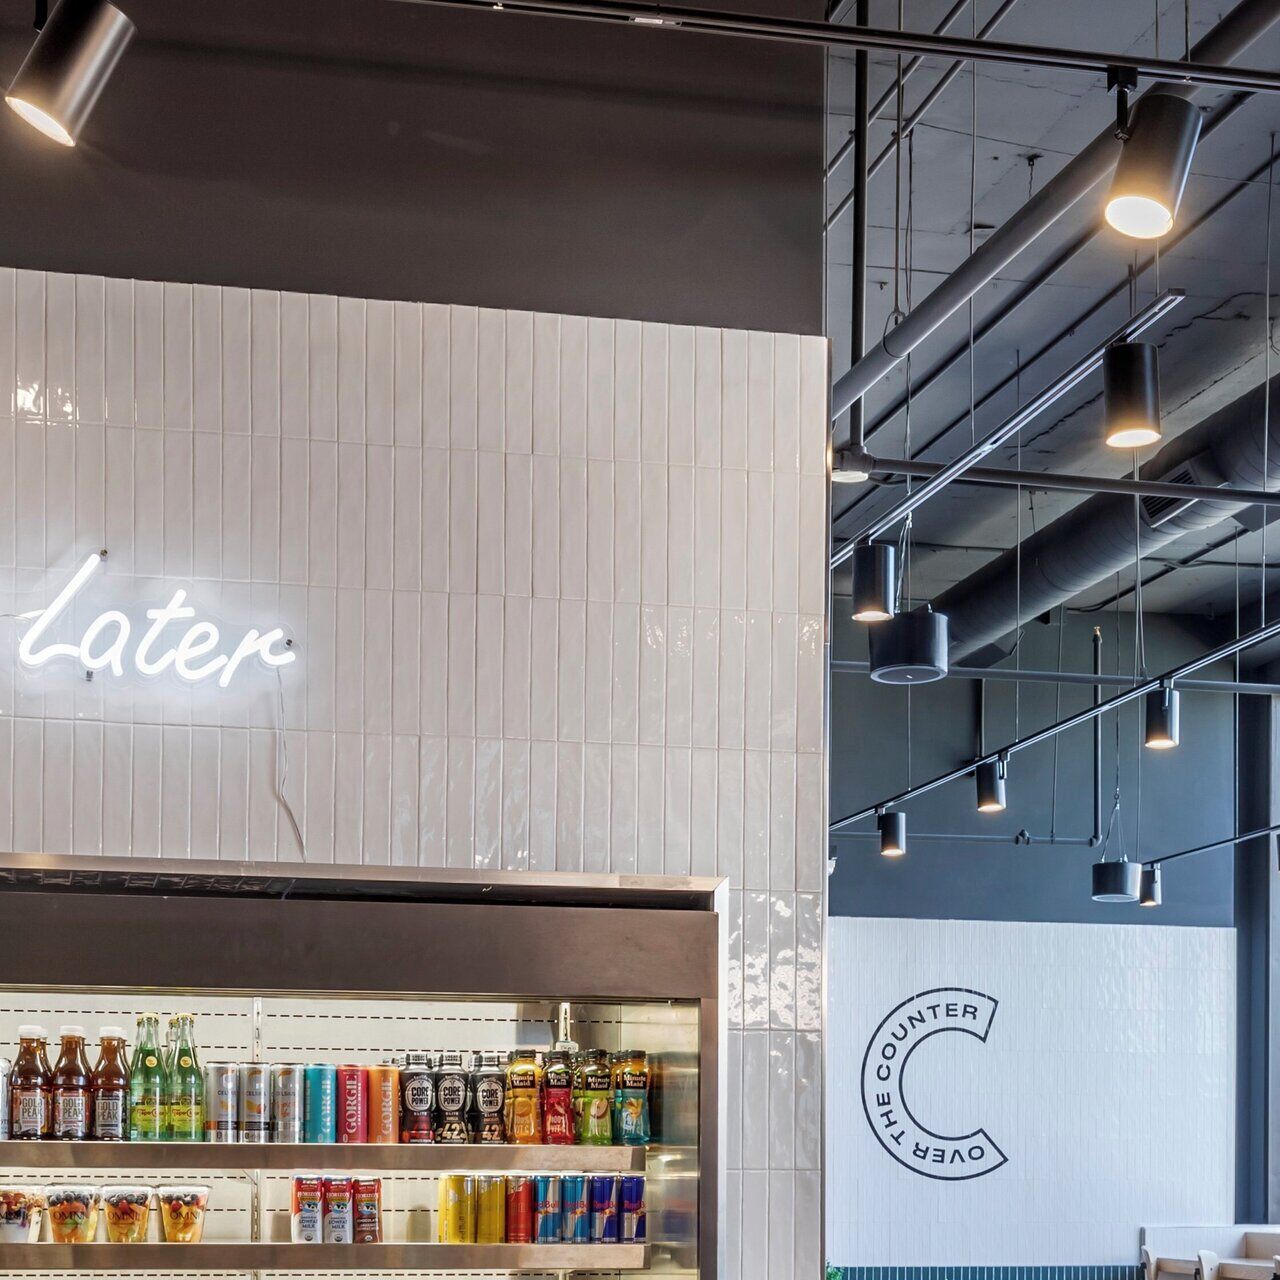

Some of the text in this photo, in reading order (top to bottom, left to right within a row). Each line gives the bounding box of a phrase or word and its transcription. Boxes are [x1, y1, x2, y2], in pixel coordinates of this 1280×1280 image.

[18, 551, 296, 690] Later
[877, 1003, 985, 1164] OVER THE COUNTER
[411, 1086, 429, 1097] CORE
[443, 1086, 461, 1097] CORE
[481, 1088, 499, 1099] CORE
[22, 1097, 42, 1108] GOLD
[97, 1101, 118, 1111] GOLD
[346, 1075, 357, 1135] GORGIE
[443, 1096, 461, 1105] POWER
[482, 1098, 499, 1106] POWER
[22, 1107, 43, 1118] PEAK
[98, 1110, 118, 1121] PEAK
